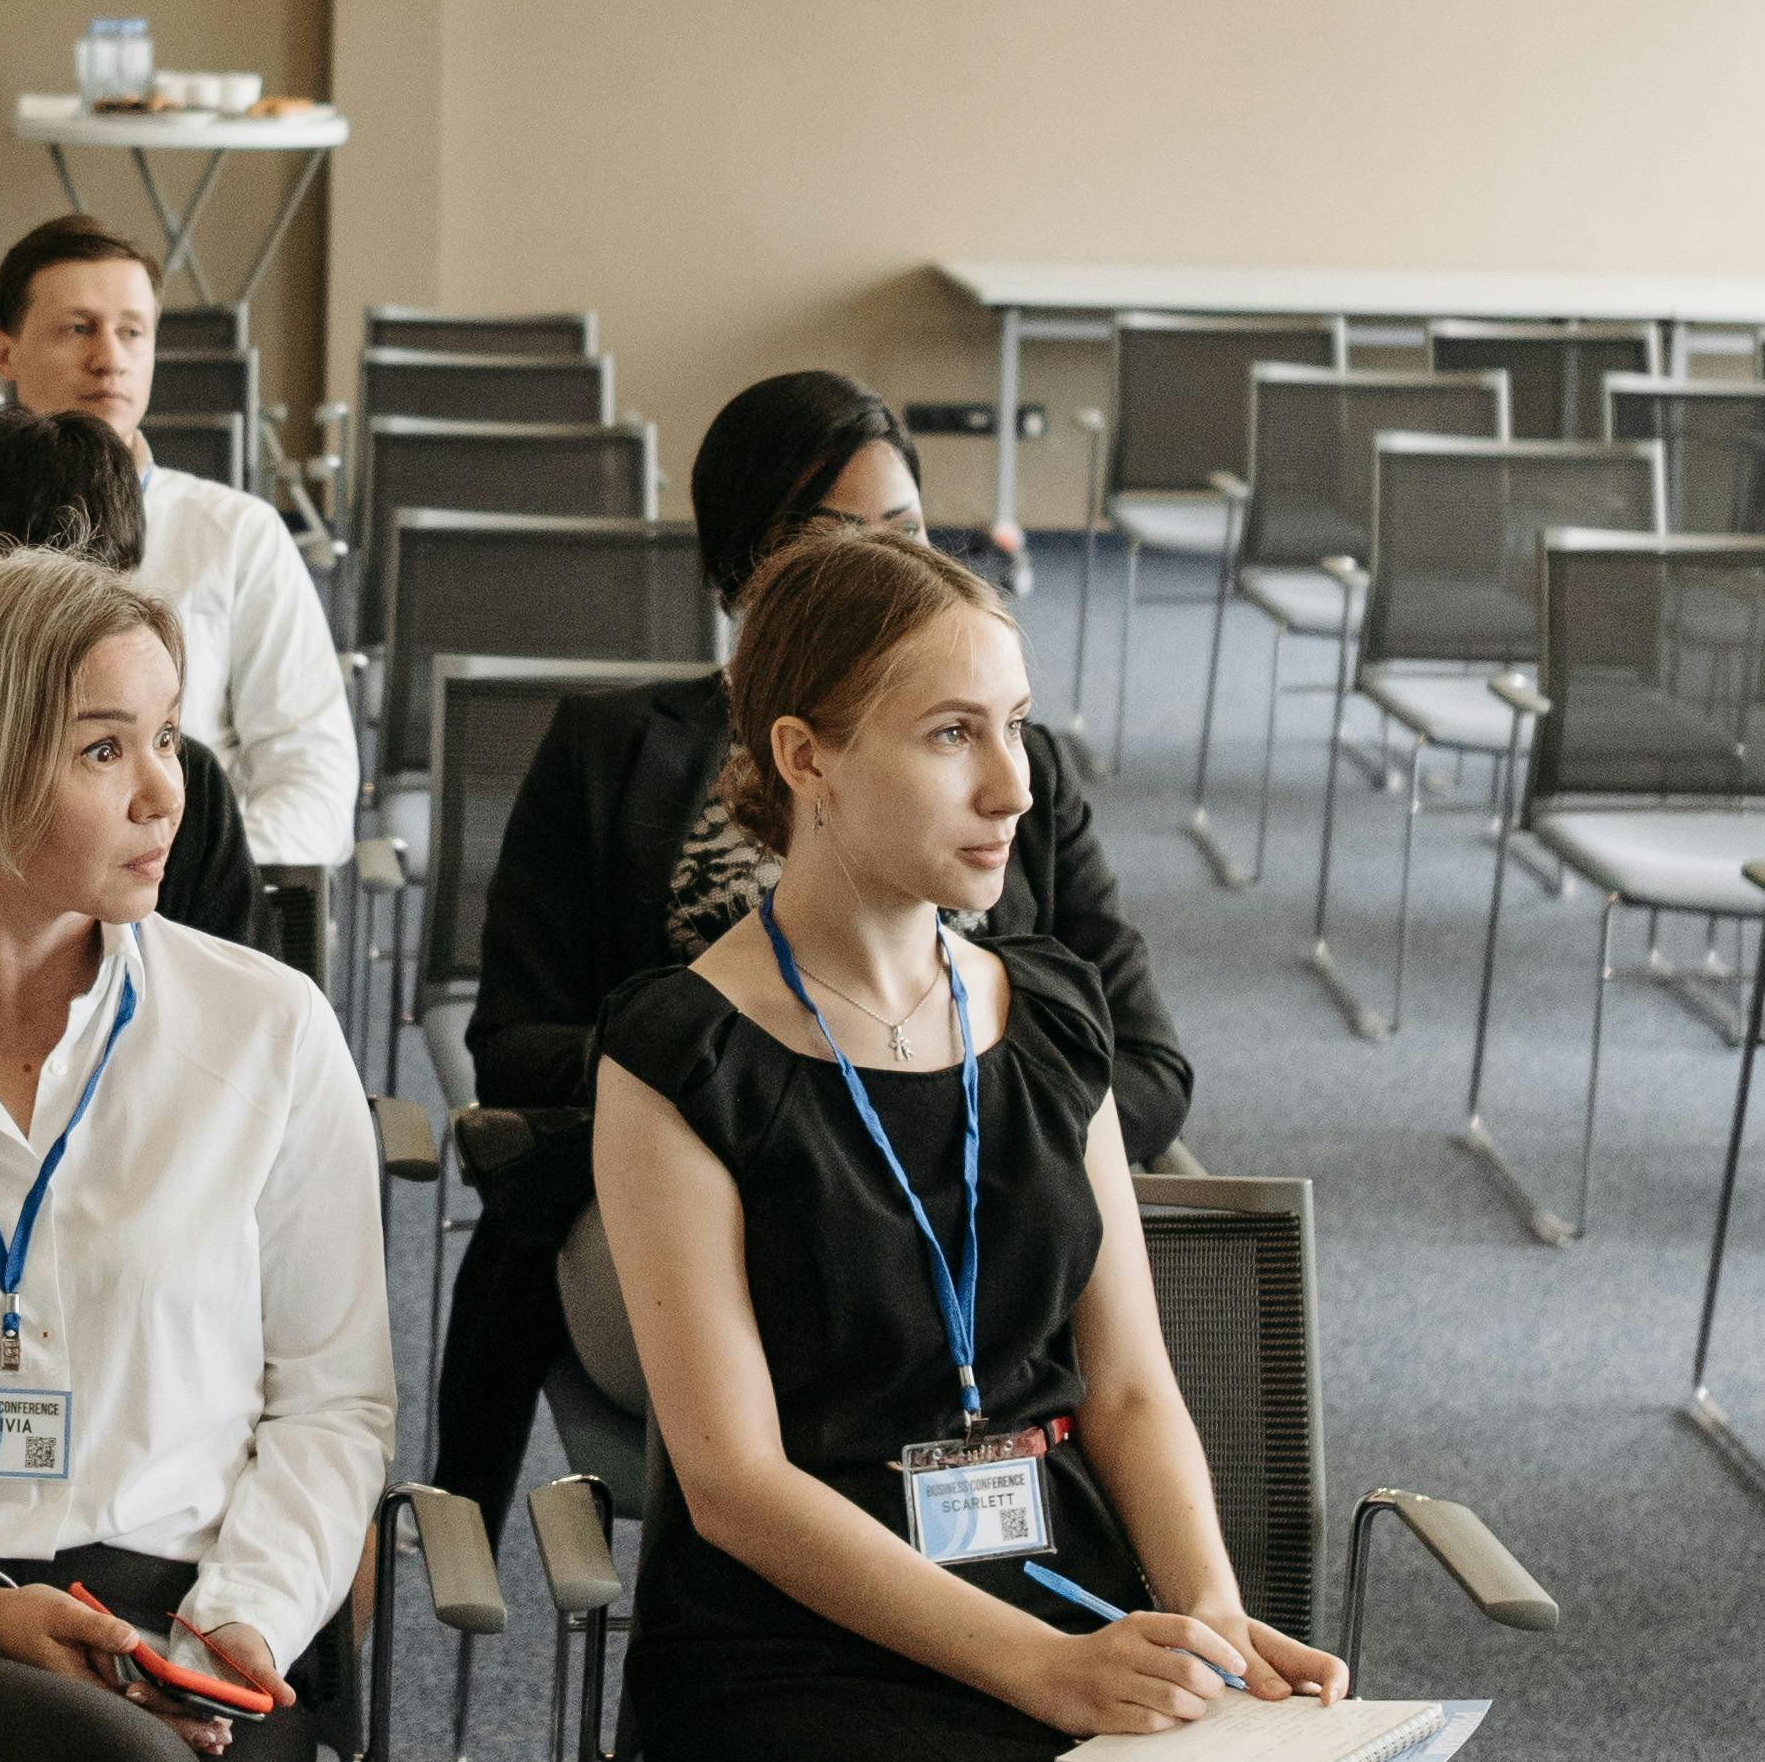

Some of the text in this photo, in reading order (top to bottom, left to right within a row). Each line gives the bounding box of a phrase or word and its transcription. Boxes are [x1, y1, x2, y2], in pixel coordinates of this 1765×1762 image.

[926, 1473, 1025, 1497] BUSINESS CONFERENCE
[942, 1493, 1014, 1513] SCARLETT
